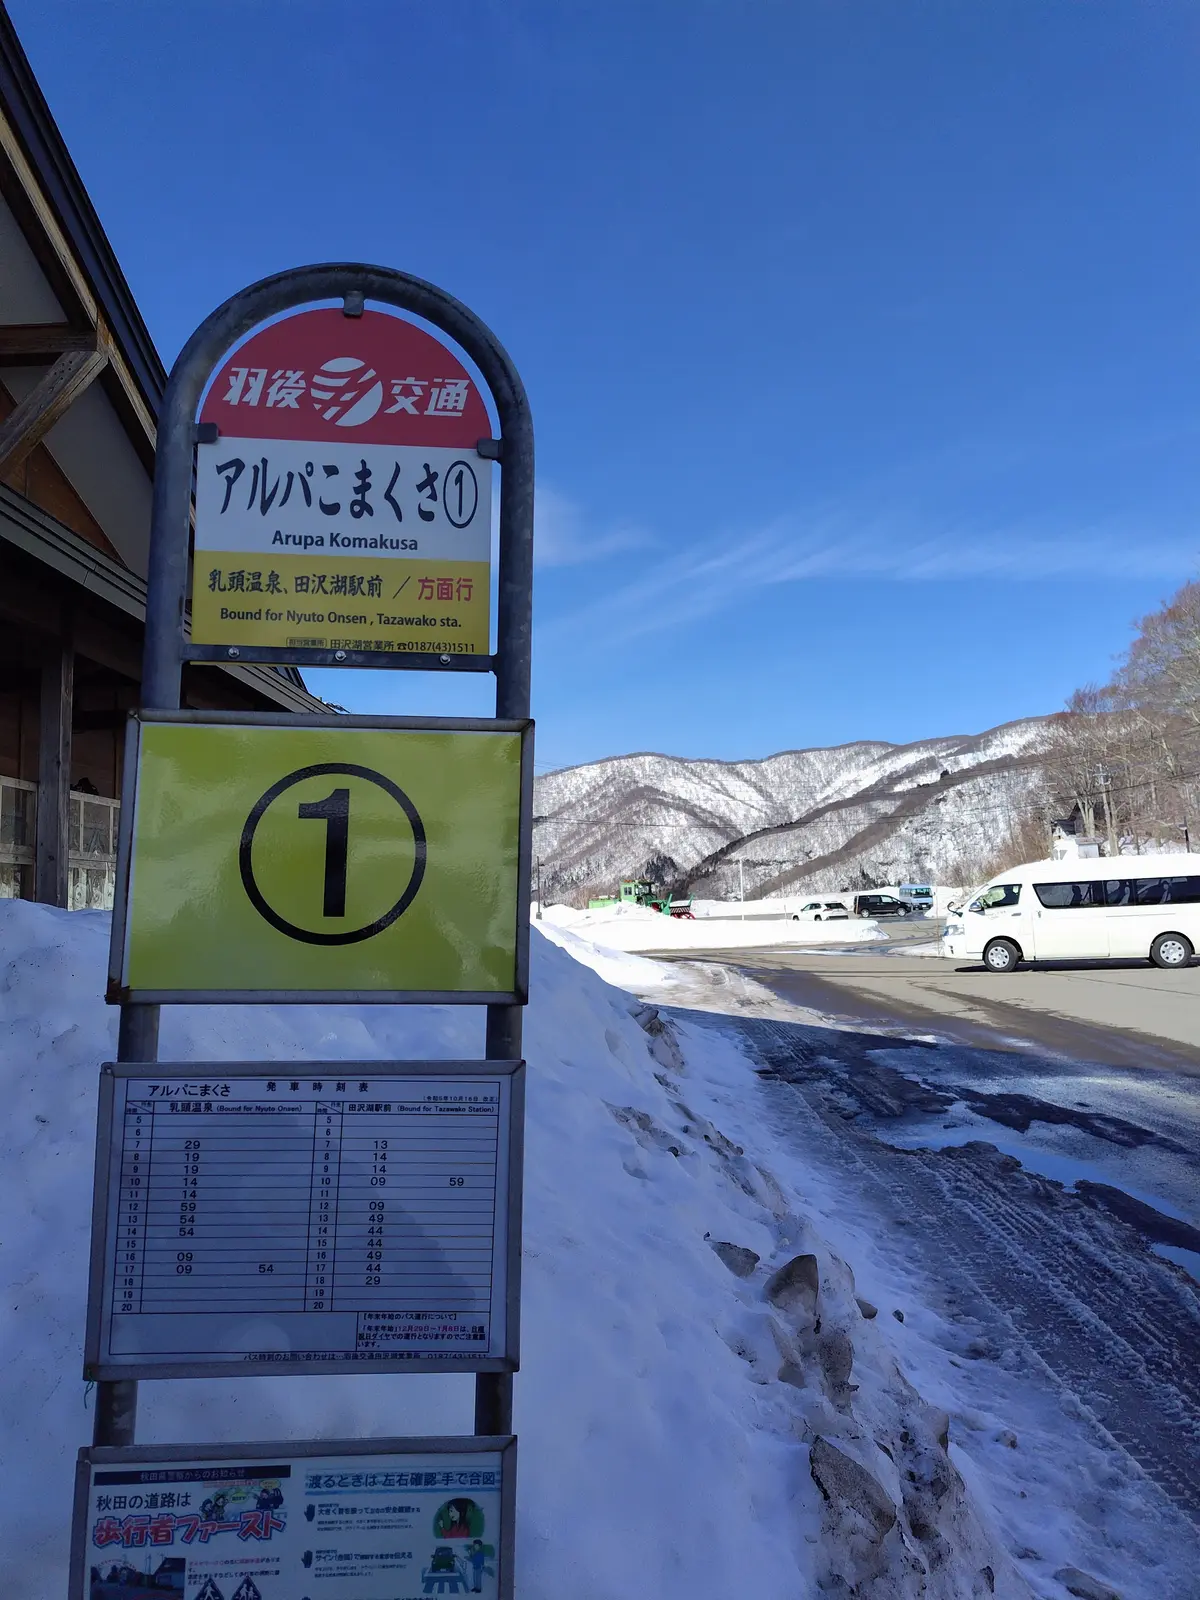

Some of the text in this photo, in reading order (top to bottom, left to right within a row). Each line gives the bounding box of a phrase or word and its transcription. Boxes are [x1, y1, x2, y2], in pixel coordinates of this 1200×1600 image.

[222, 367, 470, 417] 羽後 交通
[272, 530, 418, 551] Arupa Komakusa
[417, 575, 474, 602] 方面行
[220, 607, 261, 621] Bound
[265, 608, 283, 622] for
[286, 610, 324, 625] Nyuto
[328, 612, 367, 625] Onsen
[377, 614, 437, 627] Tazawako
[440, 616, 462, 628] sta.
[330, 639, 394, 651] 田沢湖営業所
[408, 641, 475, 653] 0187(43)1511
[148, 1084, 231, 1097] アルパこまくさ
[169, 1102, 213, 1113] 乳頭温泉
[348, 1103, 391, 1112] 田沢湖駅前
[136, 1116, 141, 1124] 5
[184, 1140, 200, 1149] 29
[374, 1141, 388, 1149] 13
[134, 1153, 199, 1161] 8 19
[373, 1153, 387, 1161] 14
[184, 1165, 199, 1174] 19
[373, 1165, 386, 1173] 14
[183, 1178, 198, 1186] 14
[371, 1177, 386, 1186] 09
[449, 1177, 464, 1186] 59
[182, 1190, 197, 1198] 14
[180, 1202, 196, 1211] 59
[369, 1202, 384, 1210] 09
[180, 1215, 195, 1224] 54
[369, 1214, 384, 1222] 49
[179, 1227, 194, 1237] 54
[368, 1227, 383, 1235] 44
[367, 1239, 382, 1247] 44
[126, 1252, 193, 1261] 16 09
[176, 1265, 192, 1274] 09
[258, 1264, 274, 1273] 54
[316, 1264, 381, 1272] 17 44
[124, 1278, 133, 1286] 18
[366, 1276, 381, 1285] 29
[121, 1303, 132, 1311] 20
[308, 1471, 495, 1489] 渡るときは 左右確認 手で合図
[96, 1492, 192, 1512] 秋田の道路は
[93, 1509, 286, 1548] 歩行者ファースト
